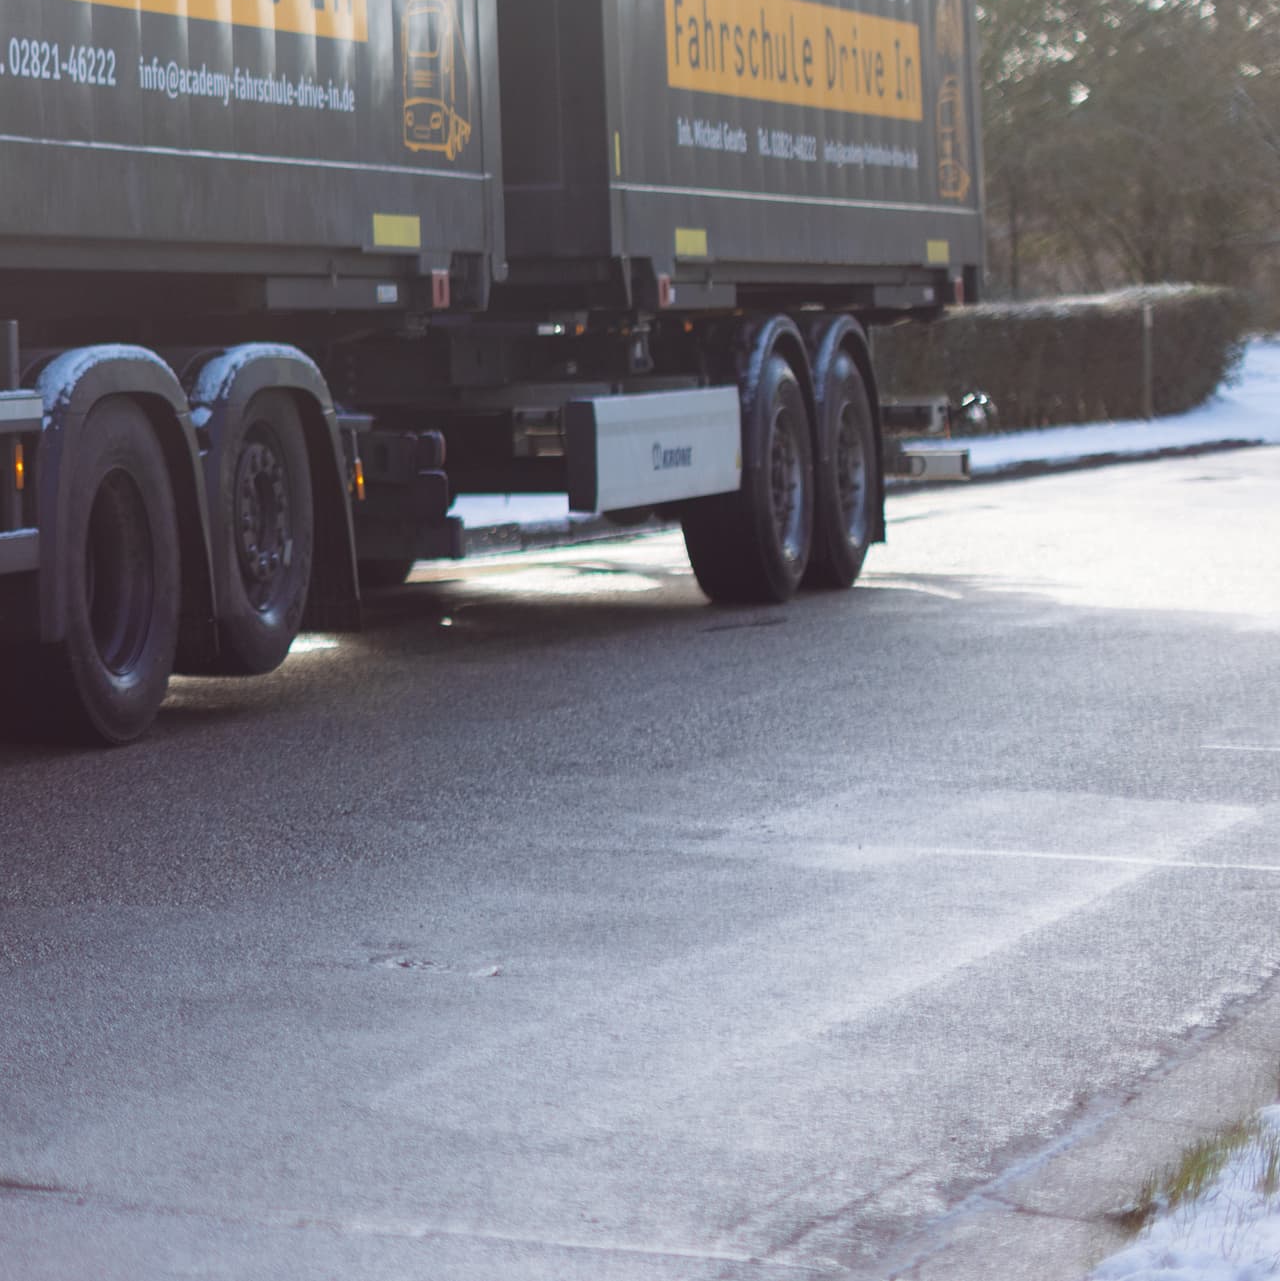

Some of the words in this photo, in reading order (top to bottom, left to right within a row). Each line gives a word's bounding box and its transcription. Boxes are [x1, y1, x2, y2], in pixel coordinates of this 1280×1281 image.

[10, 38, 116, 85] 02821-46222
[139, 56, 355, 112] info@academy-fahrschule-drive-in.de
[825, 25, 884, 96] Drive
[894, 39, 916, 103] In
